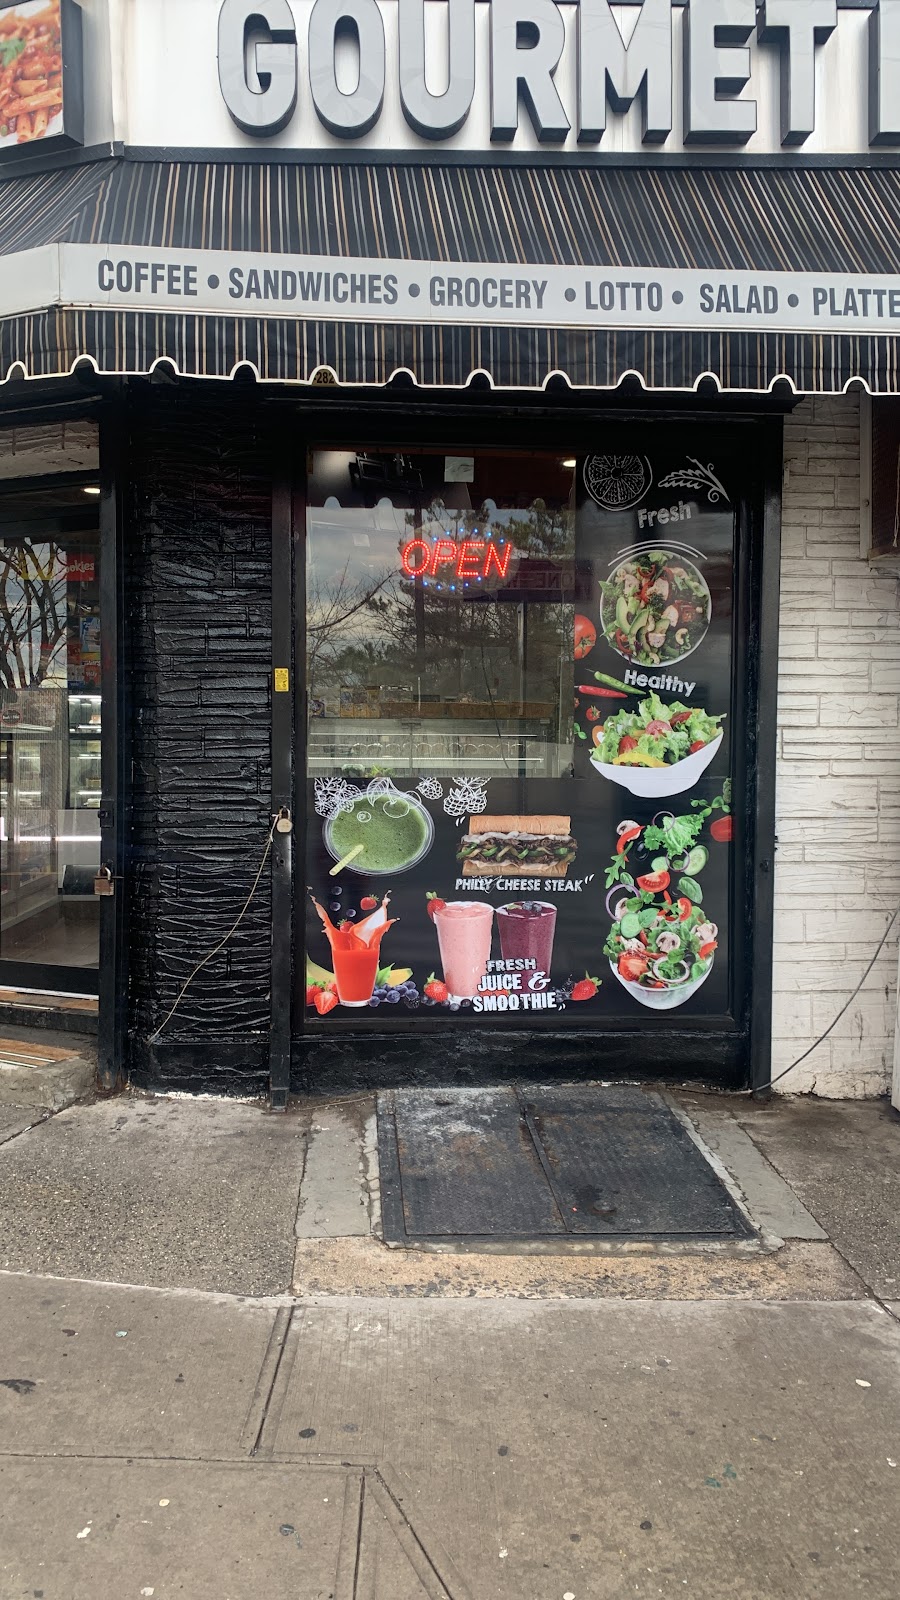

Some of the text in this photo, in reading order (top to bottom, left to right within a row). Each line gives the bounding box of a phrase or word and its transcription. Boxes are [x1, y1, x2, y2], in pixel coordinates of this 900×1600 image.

[217, 0, 838, 144] GOURMET
[98, 259, 198, 296] COFFEE
[228, 267, 399, 305] SANDWICHES
[429, 275, 549, 310] GROCERY
[585, 280, 663, 312] LOTTO
[699, 283, 778, 314] SALAD
[637, 501, 692, 529] Fresh
[402, 540, 512, 577] OPEN
[624, 669, 696, 698] Healthy
[455, 878, 583, 892] PHILLY CHEESE STEAK
[486, 958, 537, 973] FRESH
[477, 971, 551, 992] JUICE &
[472, 991, 558, 1012] SMOOTHIE
